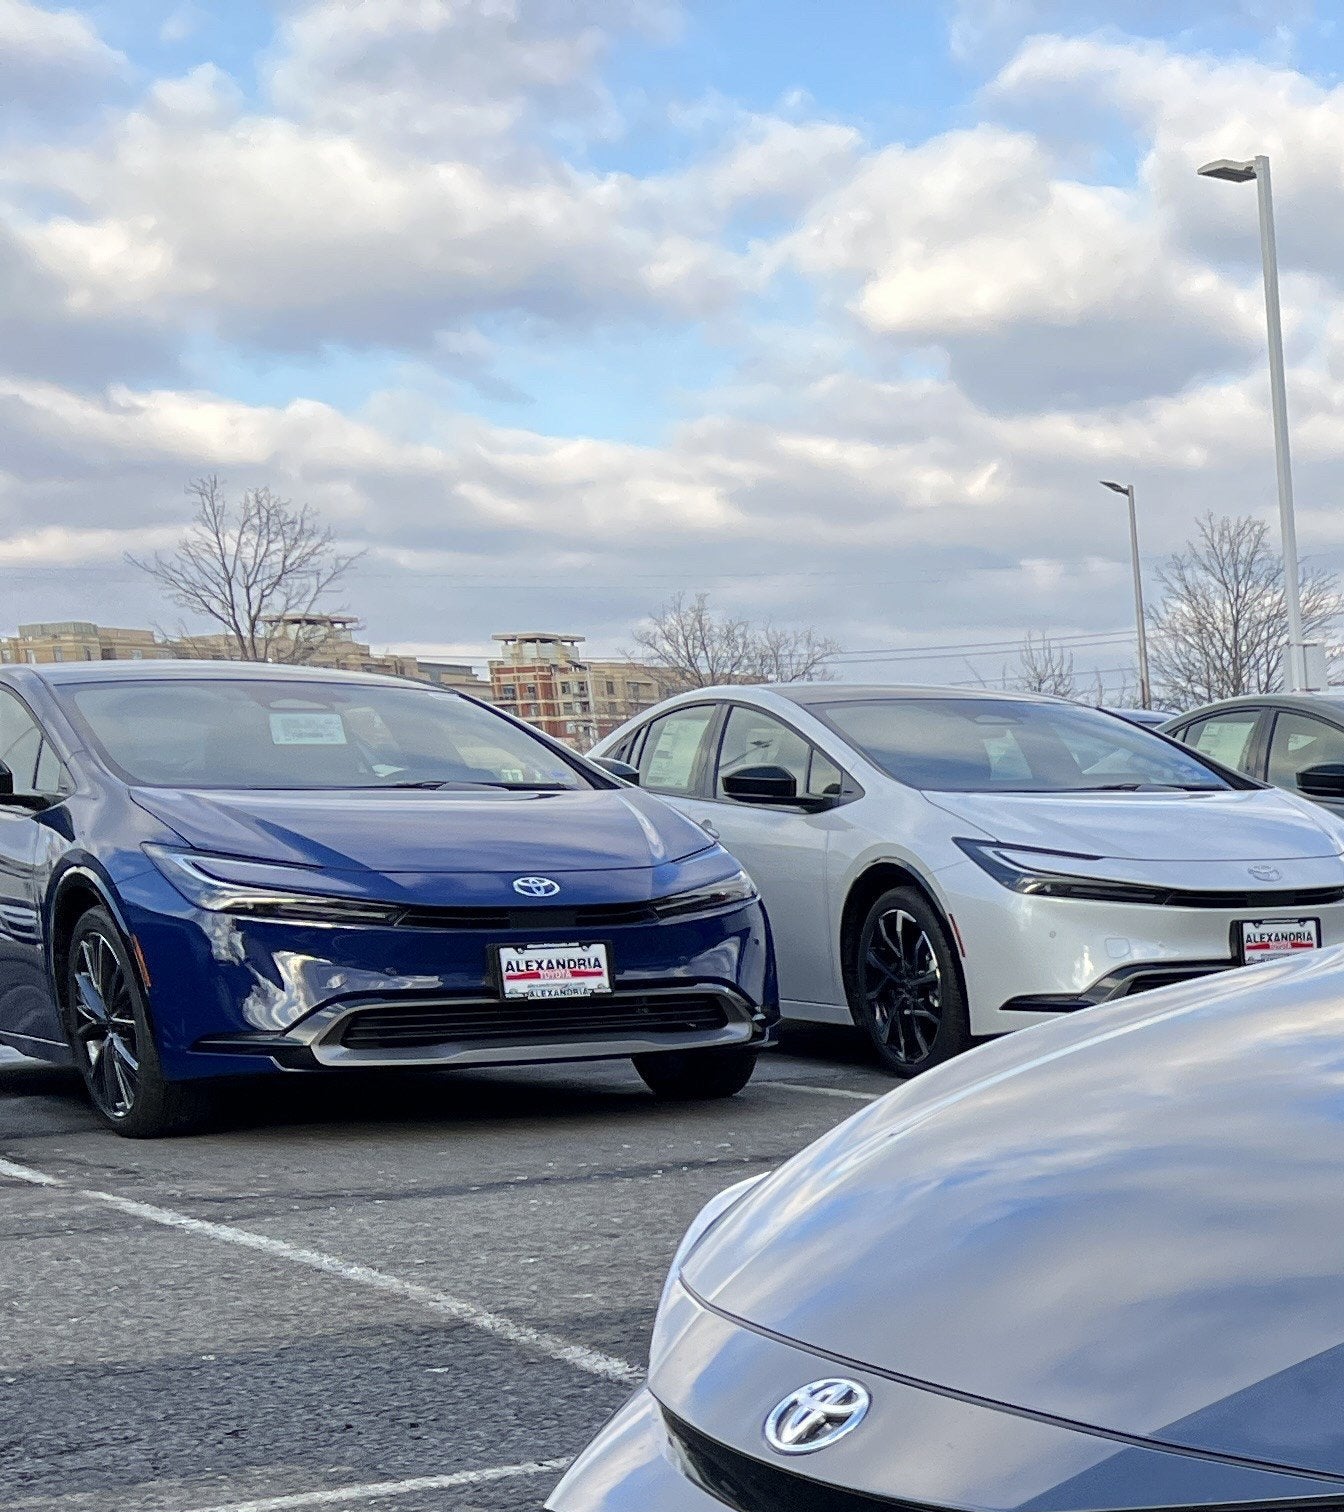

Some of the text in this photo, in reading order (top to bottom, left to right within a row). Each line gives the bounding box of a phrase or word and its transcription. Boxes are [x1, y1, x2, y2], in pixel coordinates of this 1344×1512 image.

[1246, 931, 1314, 944] ALEXANDRIA
[505, 957, 602, 972] ALEXANDRIA
[529, 988, 589, 998] ALEXANDRIA
